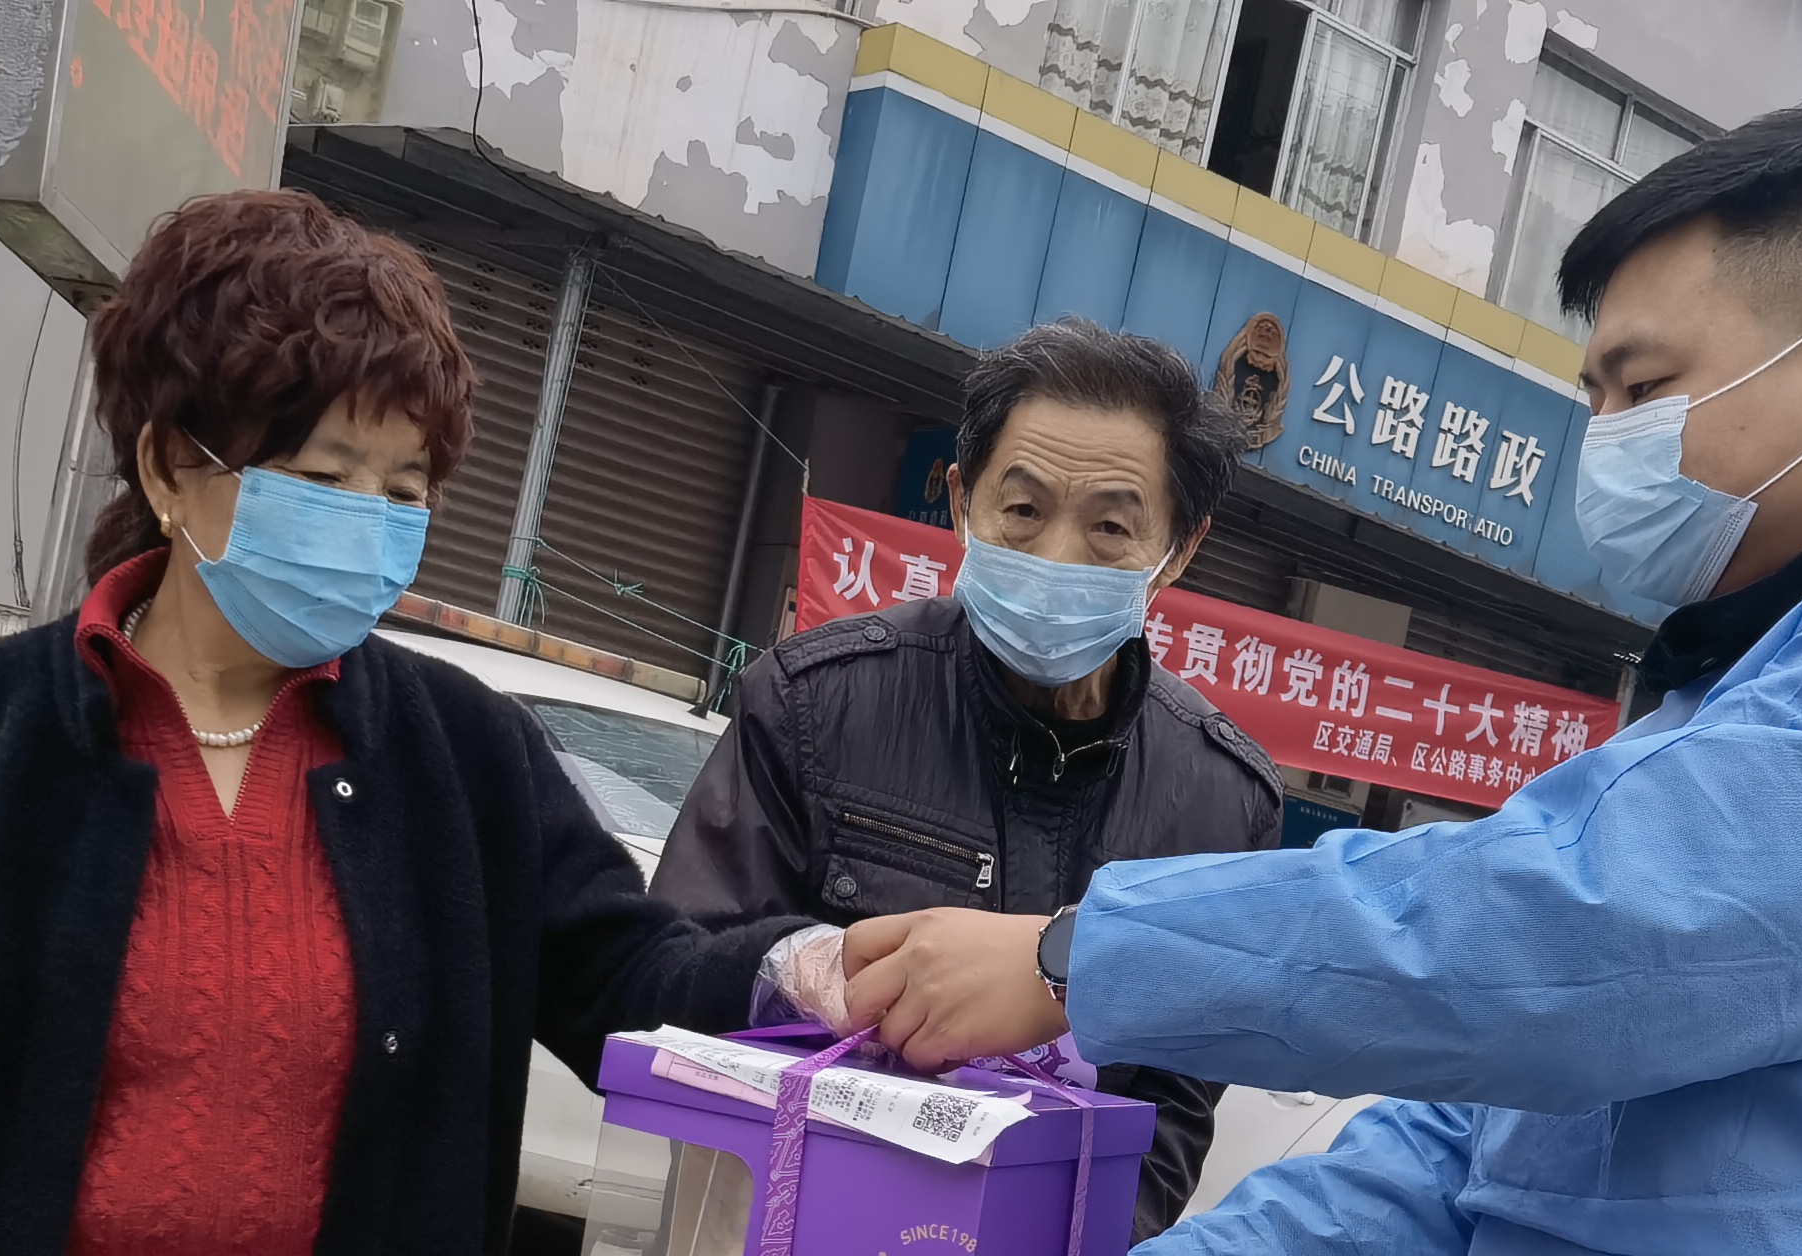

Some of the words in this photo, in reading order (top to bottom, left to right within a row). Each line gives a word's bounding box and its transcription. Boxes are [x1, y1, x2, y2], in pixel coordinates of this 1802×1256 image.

[1312, 355, 1546, 507] 公路路政
[1298, 446, 1357, 486] CHINA
[1371, 474, 1514, 546] TRANSPORATIO
